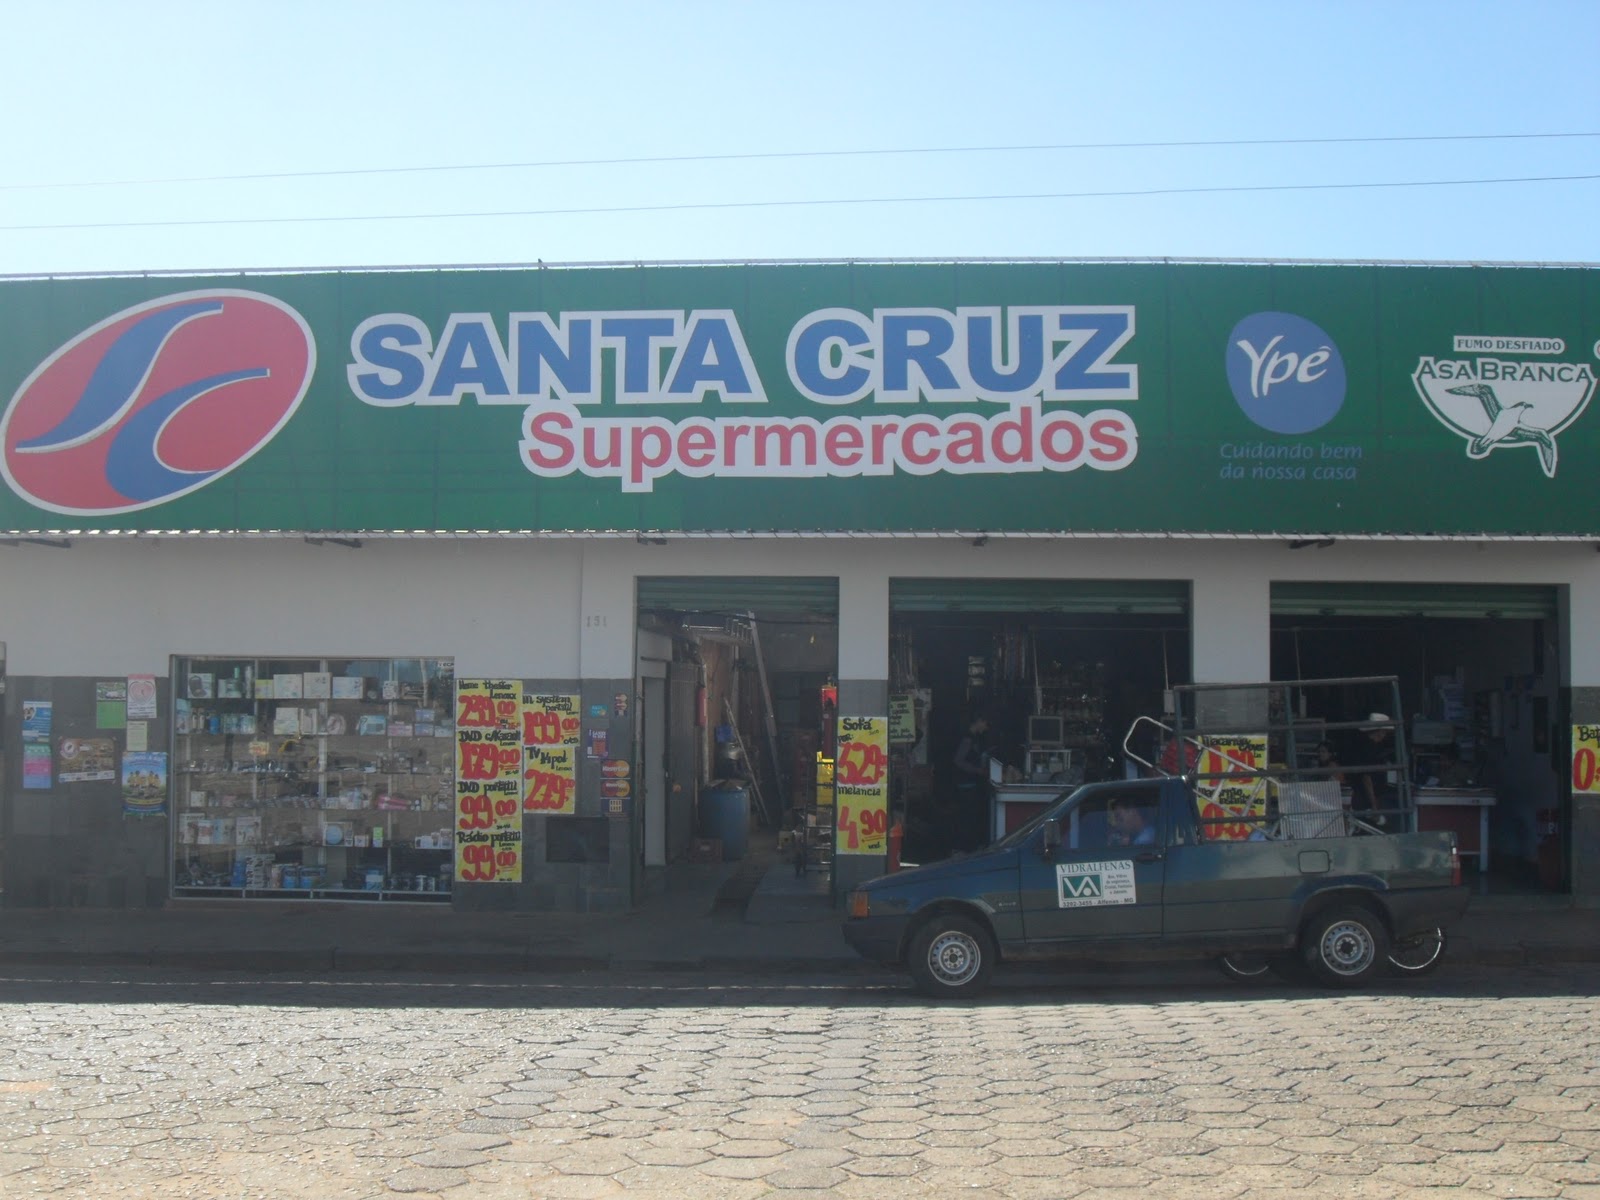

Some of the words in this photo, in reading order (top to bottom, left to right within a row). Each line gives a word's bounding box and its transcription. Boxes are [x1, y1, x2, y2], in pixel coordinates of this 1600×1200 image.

[1456, 338, 1494, 351] FUMO
[1496, 338, 1562, 352] DESFIADO
[353, 313, 758, 403] SANTA
[790, 309, 1135, 400] CRUZ
[1236, 334, 1333, 399] Ypê
[1415, 358, 1475, 381] ASA
[1481, 359, 1591, 384] BRANCA
[526, 405, 1131, 484] Supermercados
[1219, 442, 1314, 460] Cuidando
[1319, 442, 1363, 460] bem
[1219, 462, 1246, 480] da
[1251, 464, 1306, 480] nossa
[1312, 465, 1358, 481] casa
[842, 716, 874, 732] Sofá
[1059, 861, 1132, 874] VIDRALFENAS
